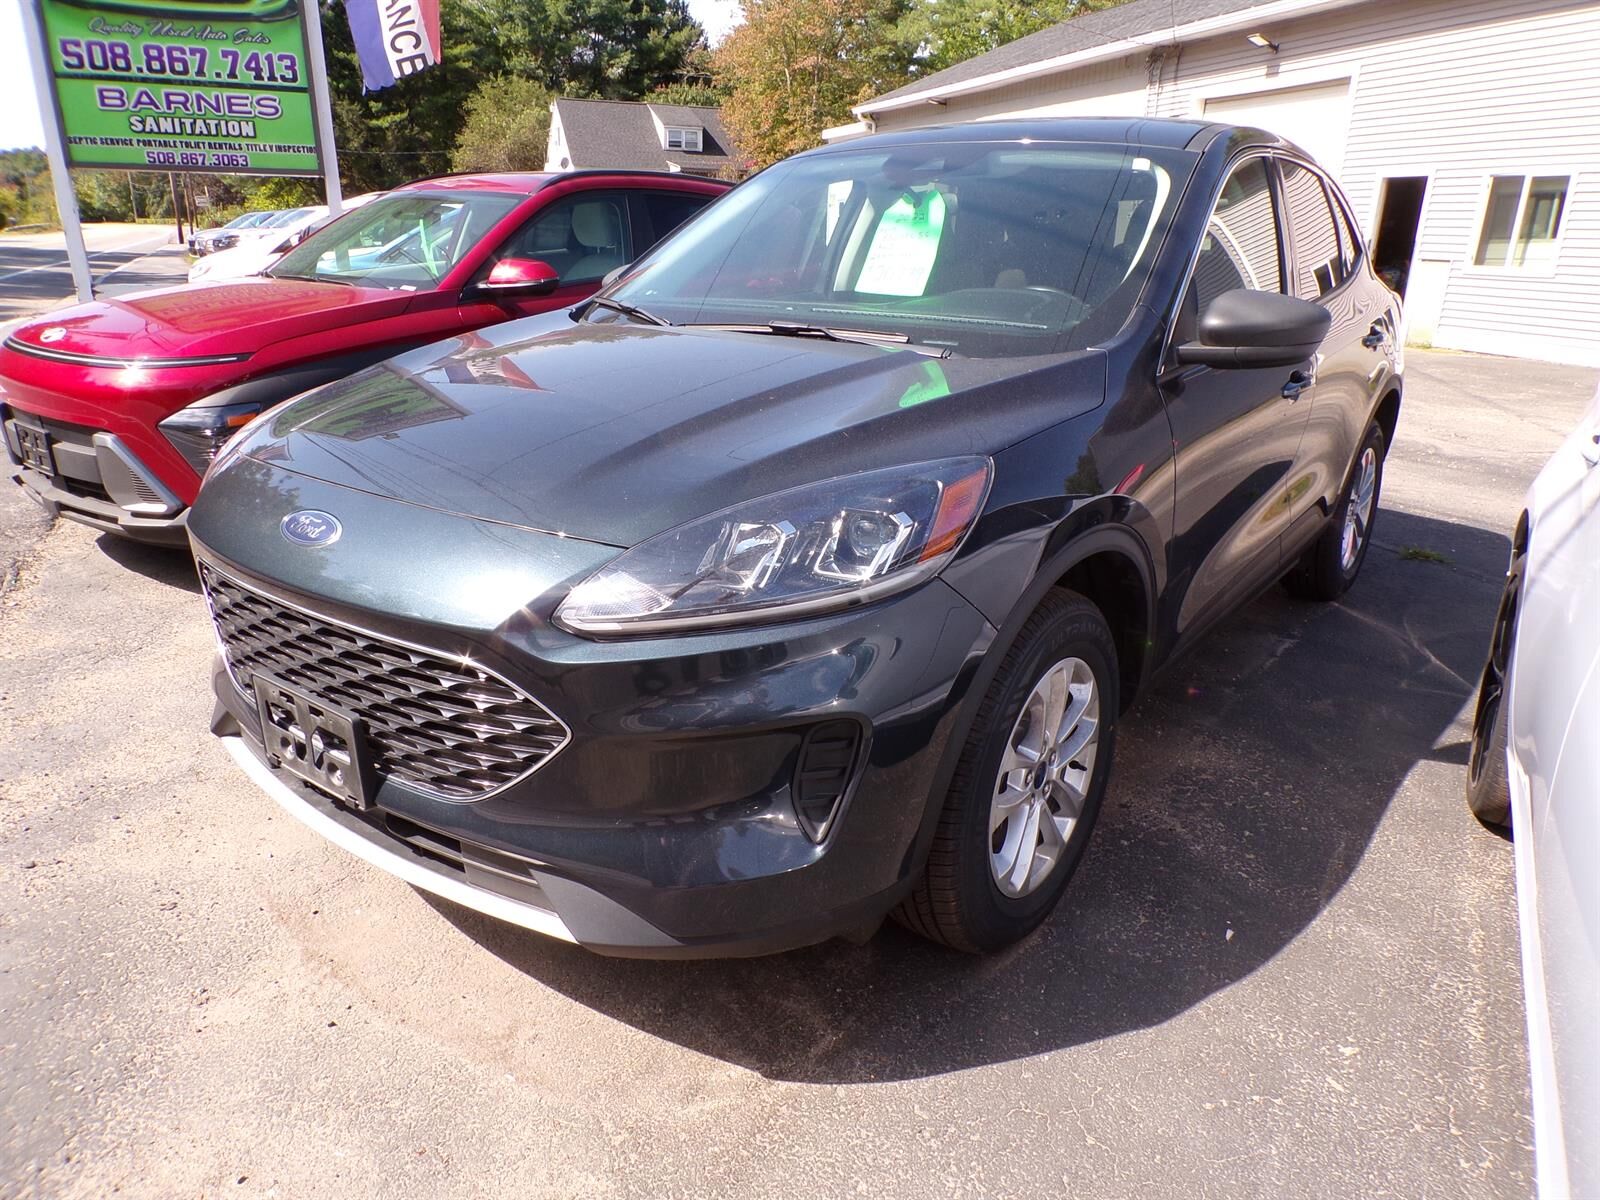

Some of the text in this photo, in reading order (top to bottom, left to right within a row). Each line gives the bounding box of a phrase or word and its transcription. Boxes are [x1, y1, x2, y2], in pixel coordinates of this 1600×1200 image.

[87, 16, 272, 45] Quality Used Auto Sales
[60, 38, 299, 84] 508.867.7413
[96, 86, 282, 119] BARNES
[129, 115, 256, 138] SANITATION
[67, 136, 98, 145] SEPTIC
[99, 137, 134, 147] SERVICE
[136, 139, 178, 149] PORTABLE
[207, 142, 243, 151] RENTALS
[244, 143, 267, 152] TITLE
[145, 151, 249, 167] 508.867.3063
[290, 515, 326, 539] Ford
